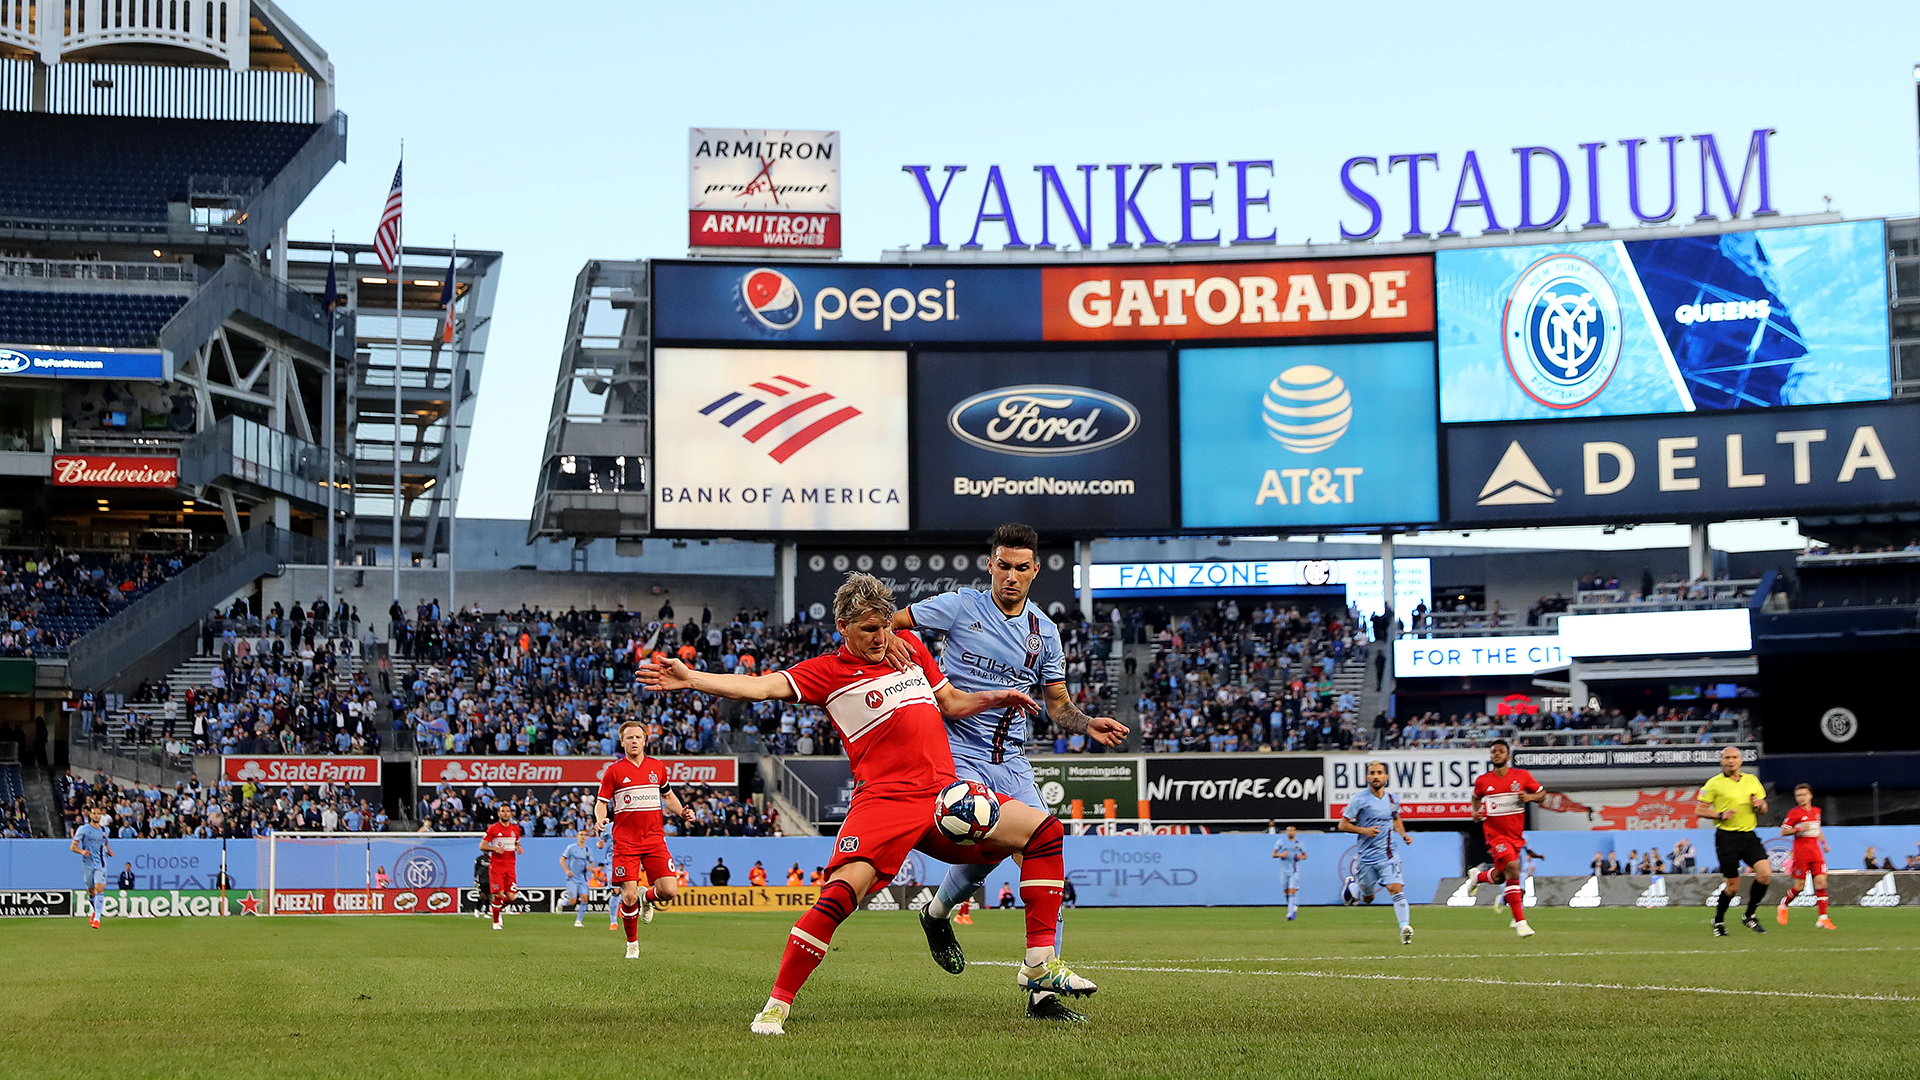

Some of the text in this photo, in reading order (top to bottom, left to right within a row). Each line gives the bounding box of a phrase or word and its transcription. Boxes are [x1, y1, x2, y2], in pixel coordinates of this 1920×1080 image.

[696, 140, 833, 160] ARMITRON
[902, 128, 1780, 250] YANKEE STADIUM
[701, 215, 827, 233] ARMITRON
[763, 232, 825, 245] WATCHES
[814, 279, 956, 331] pepsi
[1067, 271, 1408, 328] GATORADE
[1675, 300, 1770, 324] QUEENS
[986, 395, 1101, 442] Ford
[54, 459, 177, 483] Budweiser
[1582, 425, 1897, 496] DELTA
[662, 487, 900, 503] BANK OF AMERICA
[953, 476, 1135, 499] BuyFordNow.com
[1254, 467, 1364, 505] AT&T
[1120, 563, 1269, 586] FAN ZONE
[909, 577, 941, 599] York
[961, 652, 1032, 681] ETIHAD
[1413, 649, 1461, 666] FOR
[1471, 647, 1516, 664] THE
[970, 668, 1018, 688] AIRWAYS
[1069, 766, 1131, 777] Morningside
[1334, 761, 1493, 789] BUWEISE
[1147, 774, 1325, 802] NITTOTIRE.COM
[135, 854, 199, 869] Choose
[1100, 849, 1162, 864] Choose
[1066, 868, 1198, 886] ETIHAD
[775, 893, 815, 906] TIRE
